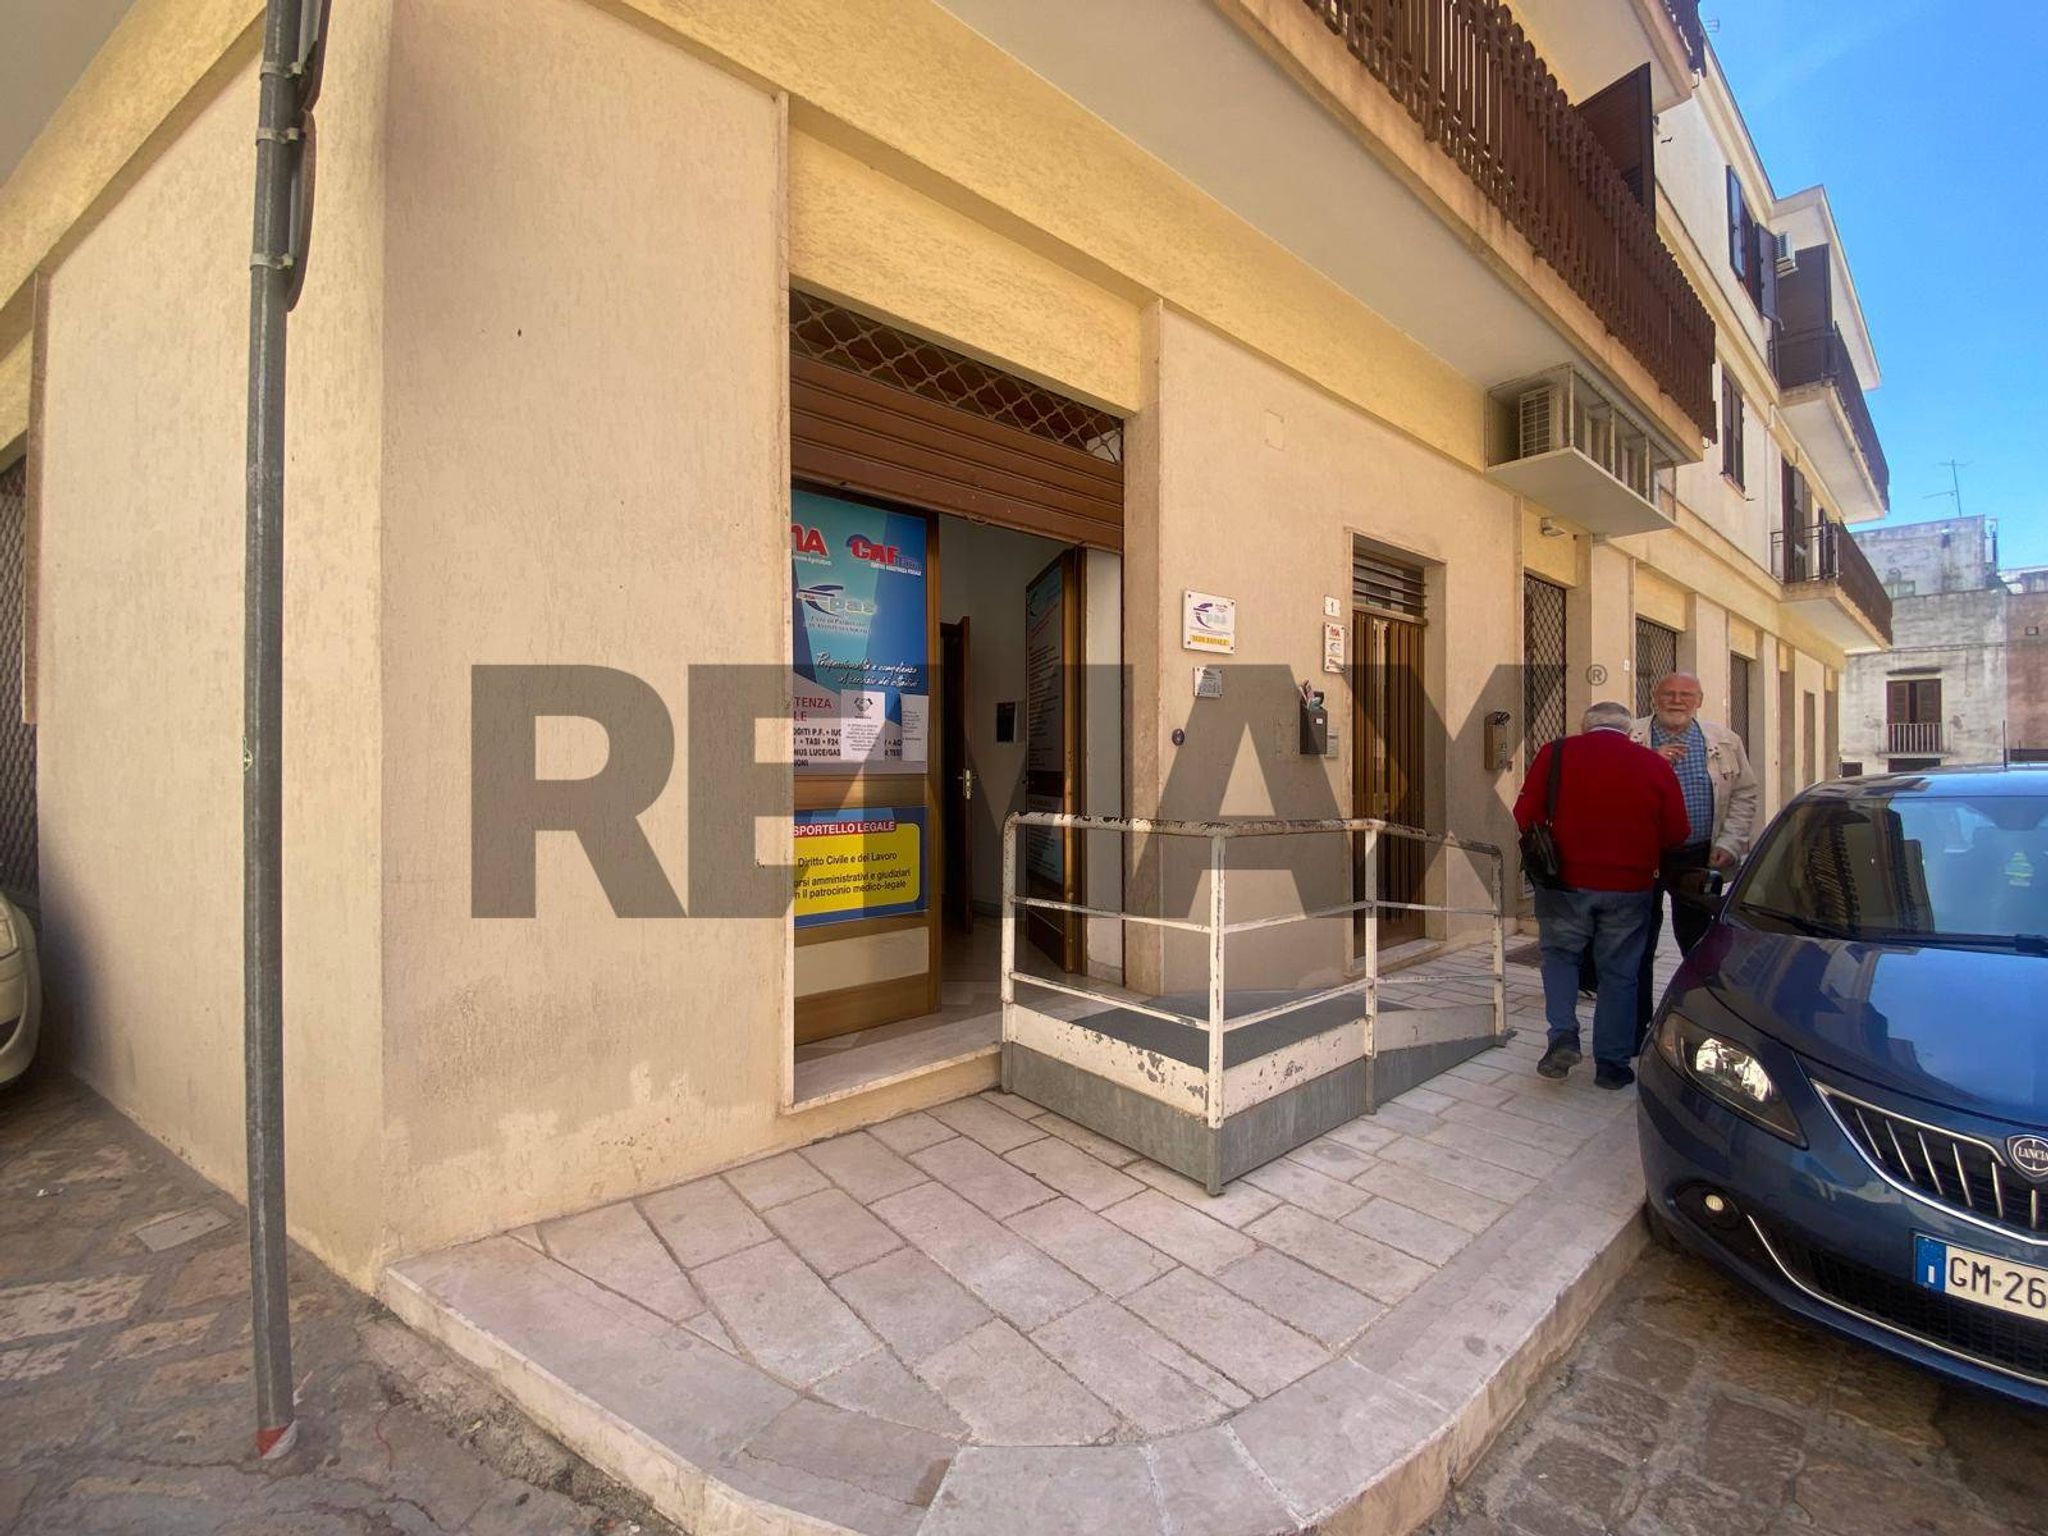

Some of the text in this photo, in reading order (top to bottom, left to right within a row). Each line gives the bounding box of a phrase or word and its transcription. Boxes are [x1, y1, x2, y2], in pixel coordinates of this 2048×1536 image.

[851, 537, 899, 566] CAF
[793, 821, 895, 837] SPORTELLO LEGALE
[798, 857, 824, 868] Diritto
[826, 854, 849, 865] Civile
[857, 853, 870, 862] del
[871, 851, 898, 862] Lavoro
[812, 872, 869, 886] amministrativi
[877, 868, 911, 882] giudiziari
[809, 884, 851, 900] patrocinio
[853, 880, 906, 894] medico-legale
